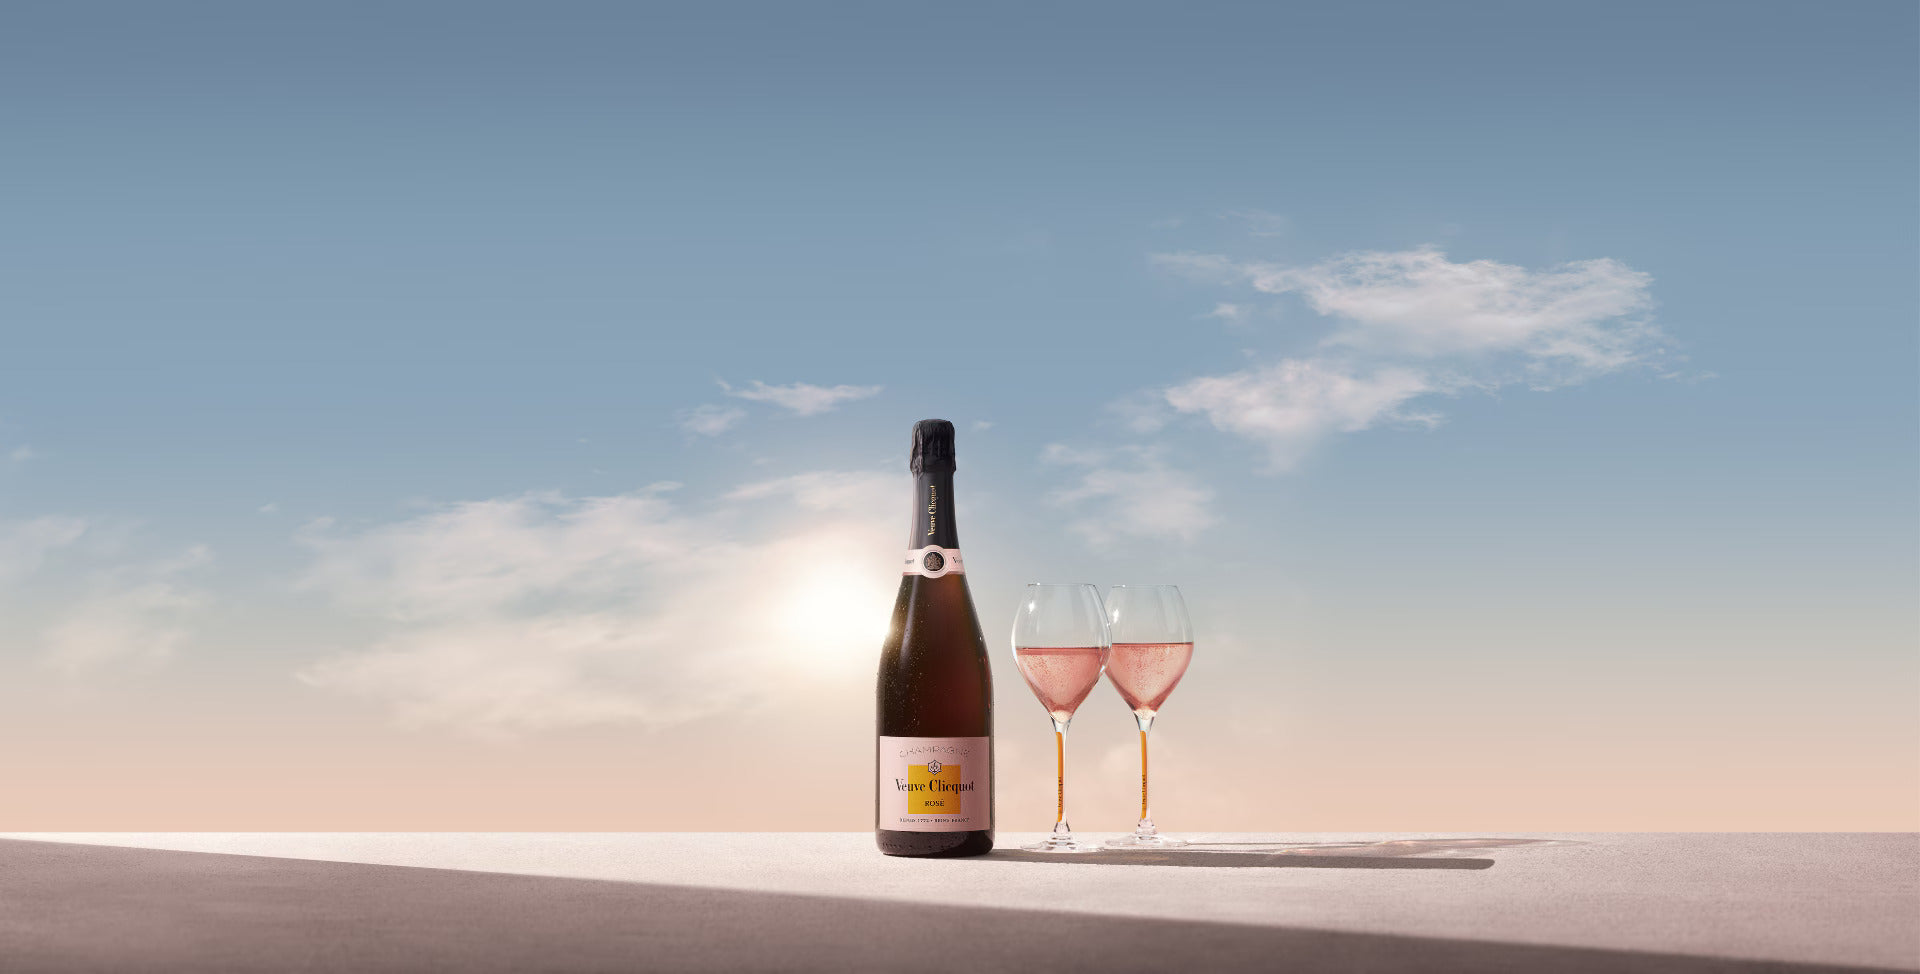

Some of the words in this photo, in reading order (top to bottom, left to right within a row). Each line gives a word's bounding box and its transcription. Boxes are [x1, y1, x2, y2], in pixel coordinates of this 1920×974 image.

[895, 778, 926, 792] Veuve
[929, 779, 975, 794] Clicquot
[924, 798, 945, 807] ROSÉ
